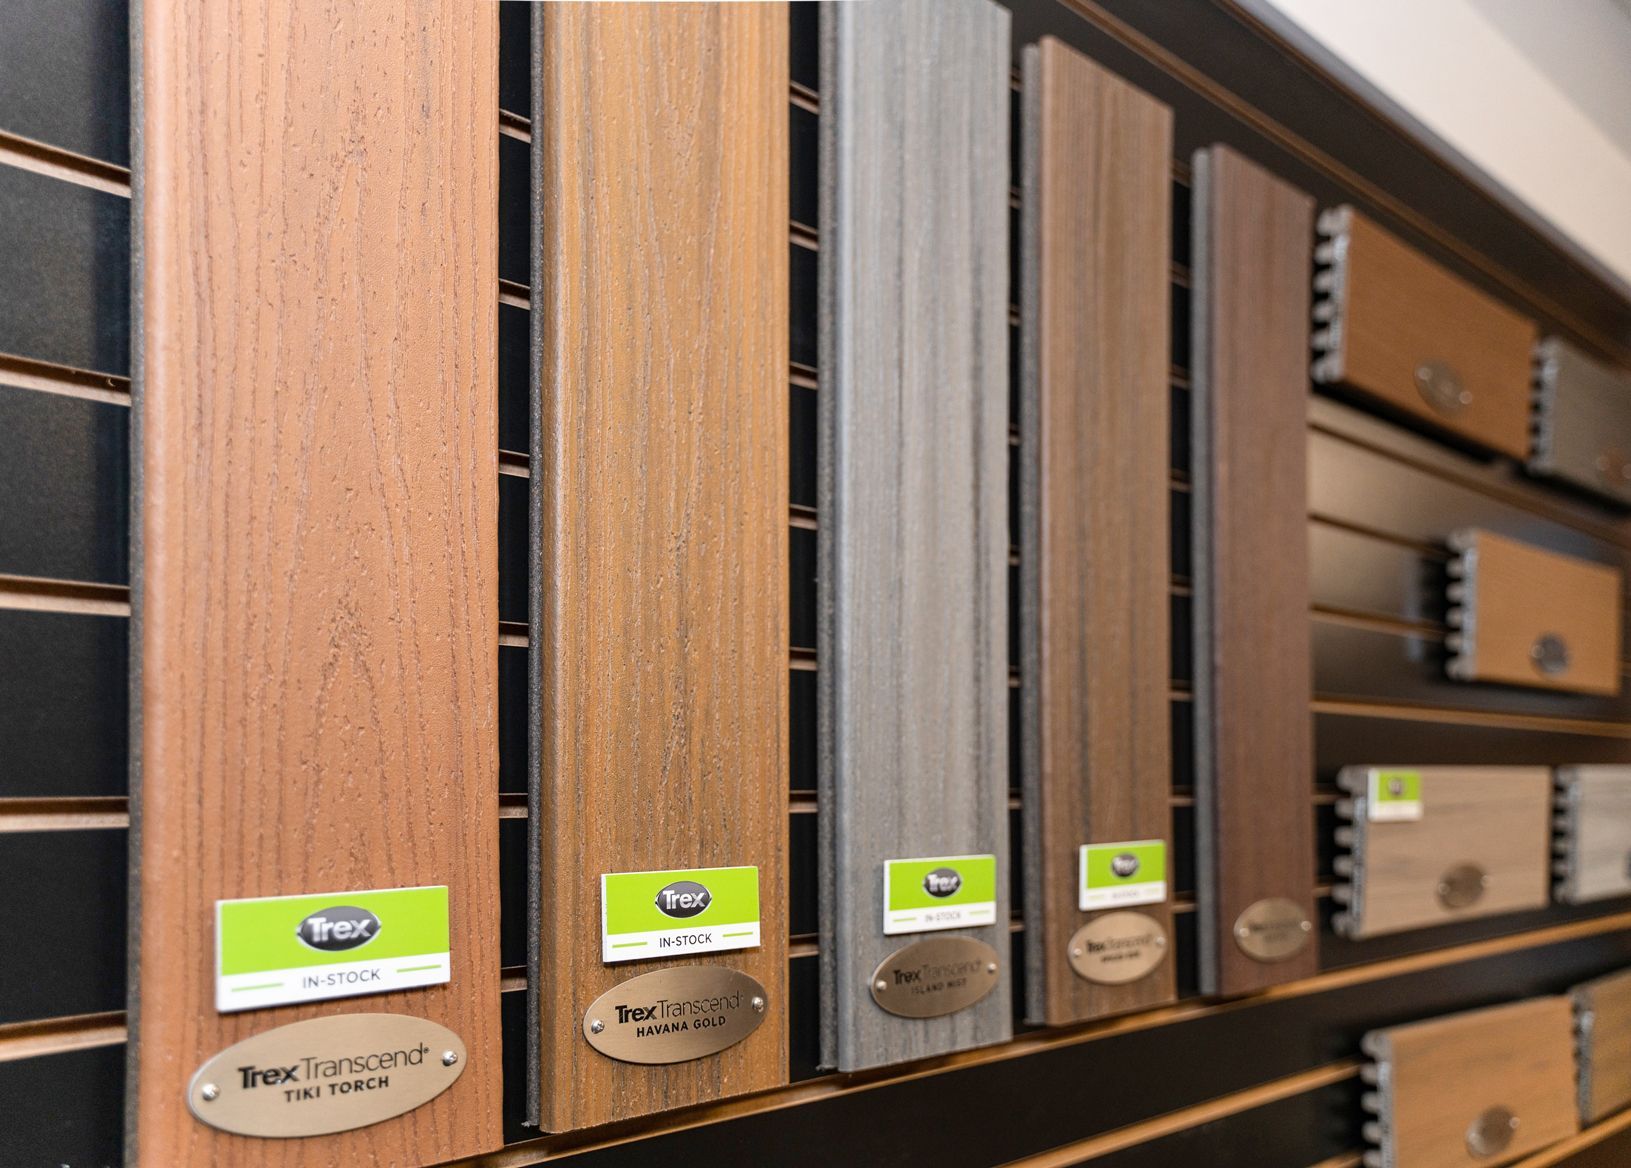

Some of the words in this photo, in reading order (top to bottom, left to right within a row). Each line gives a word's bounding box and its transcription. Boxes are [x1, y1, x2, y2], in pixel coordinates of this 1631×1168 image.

[927, 874, 959, 893] Trex
[662, 889, 706, 911] Trex
[307, 916, 372, 943] Trex
[659, 933, 713, 949] IN-STOCK
[302, 968, 381, 990] IN-STOCK
[636, 1021, 689, 1038] HAVANA
[693, 1015, 726, 1029] GOLD
[284, 1085, 321, 1103] TIKI
[329, 1075, 390, 1096] TORCH
